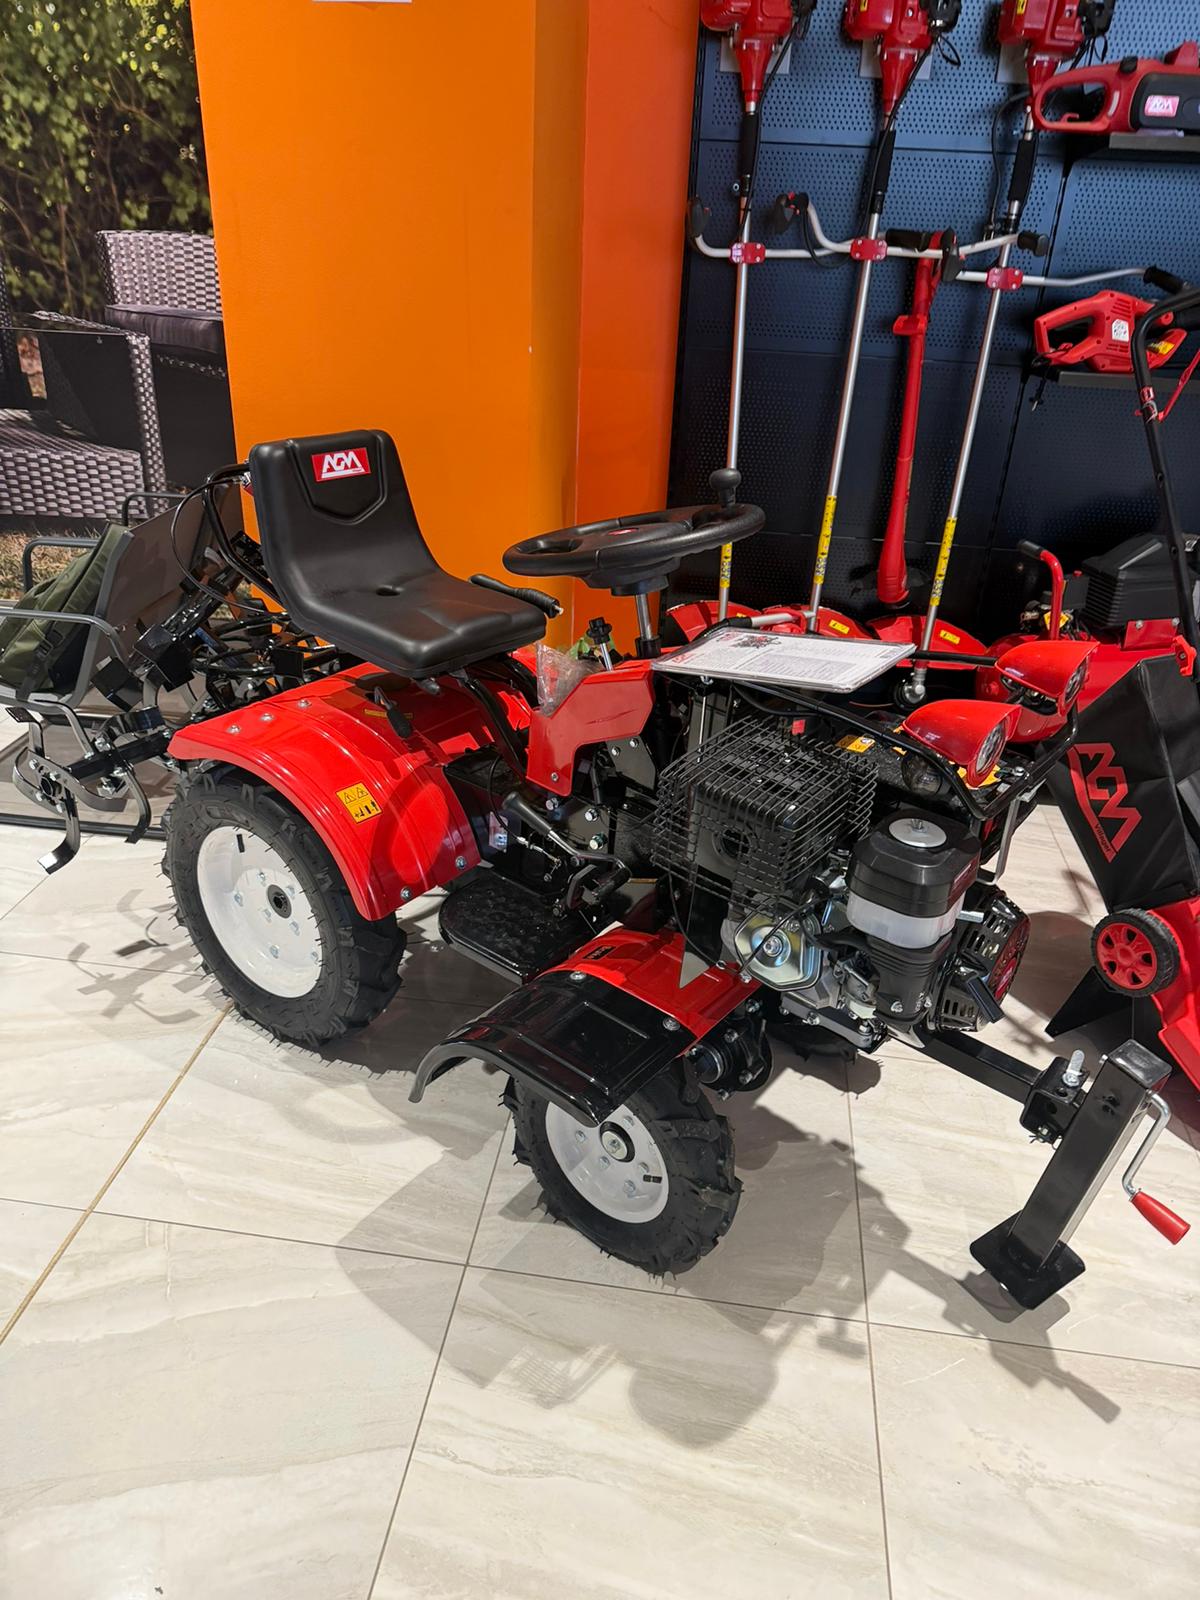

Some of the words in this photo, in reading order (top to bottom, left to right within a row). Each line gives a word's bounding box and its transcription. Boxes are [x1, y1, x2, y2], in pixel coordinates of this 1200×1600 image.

[321, 451, 365, 477] AGM
[1069, 743, 1142, 856] AGM
[1094, 823, 1112, 853] Villager
